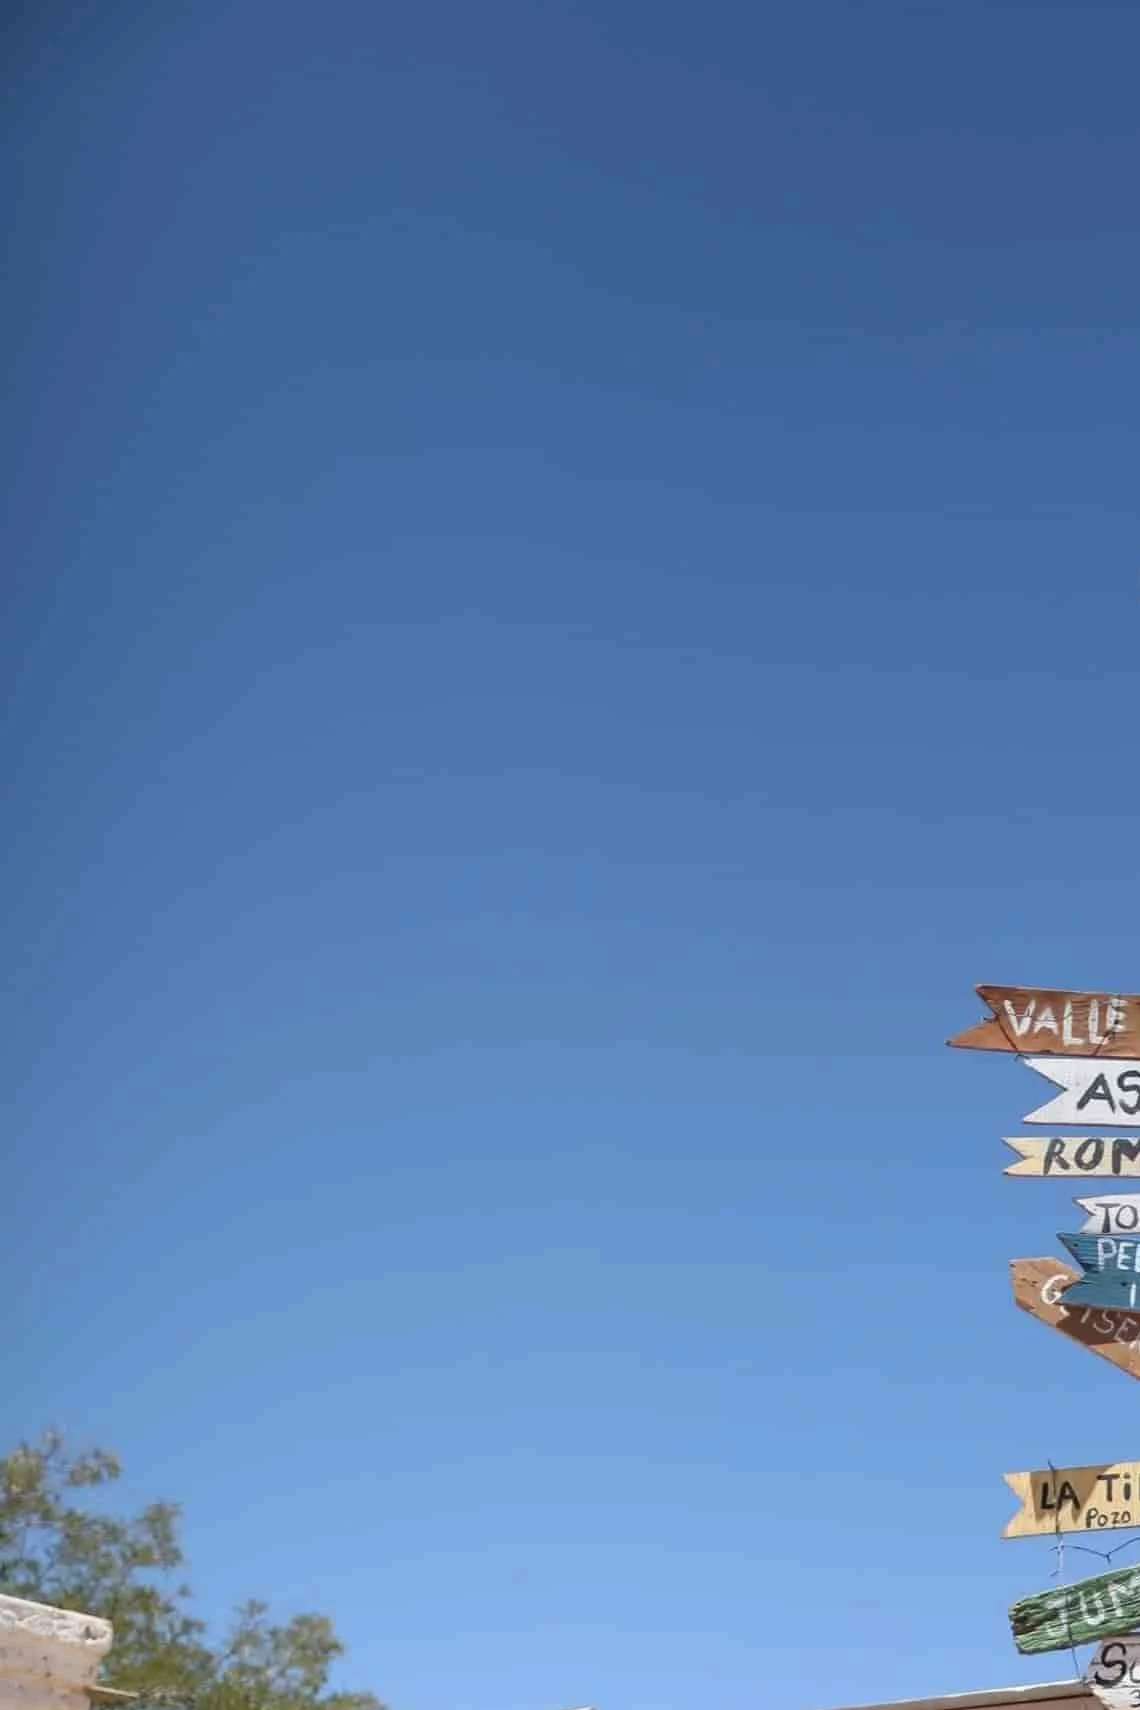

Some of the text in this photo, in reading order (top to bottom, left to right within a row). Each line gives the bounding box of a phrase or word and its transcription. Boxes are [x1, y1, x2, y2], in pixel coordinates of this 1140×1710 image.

[1004, 999, 1128, 1047] VALLE
[1040, 1482, 1081, 1510] LA
[1086, 1510, 1131, 1529] POZO
